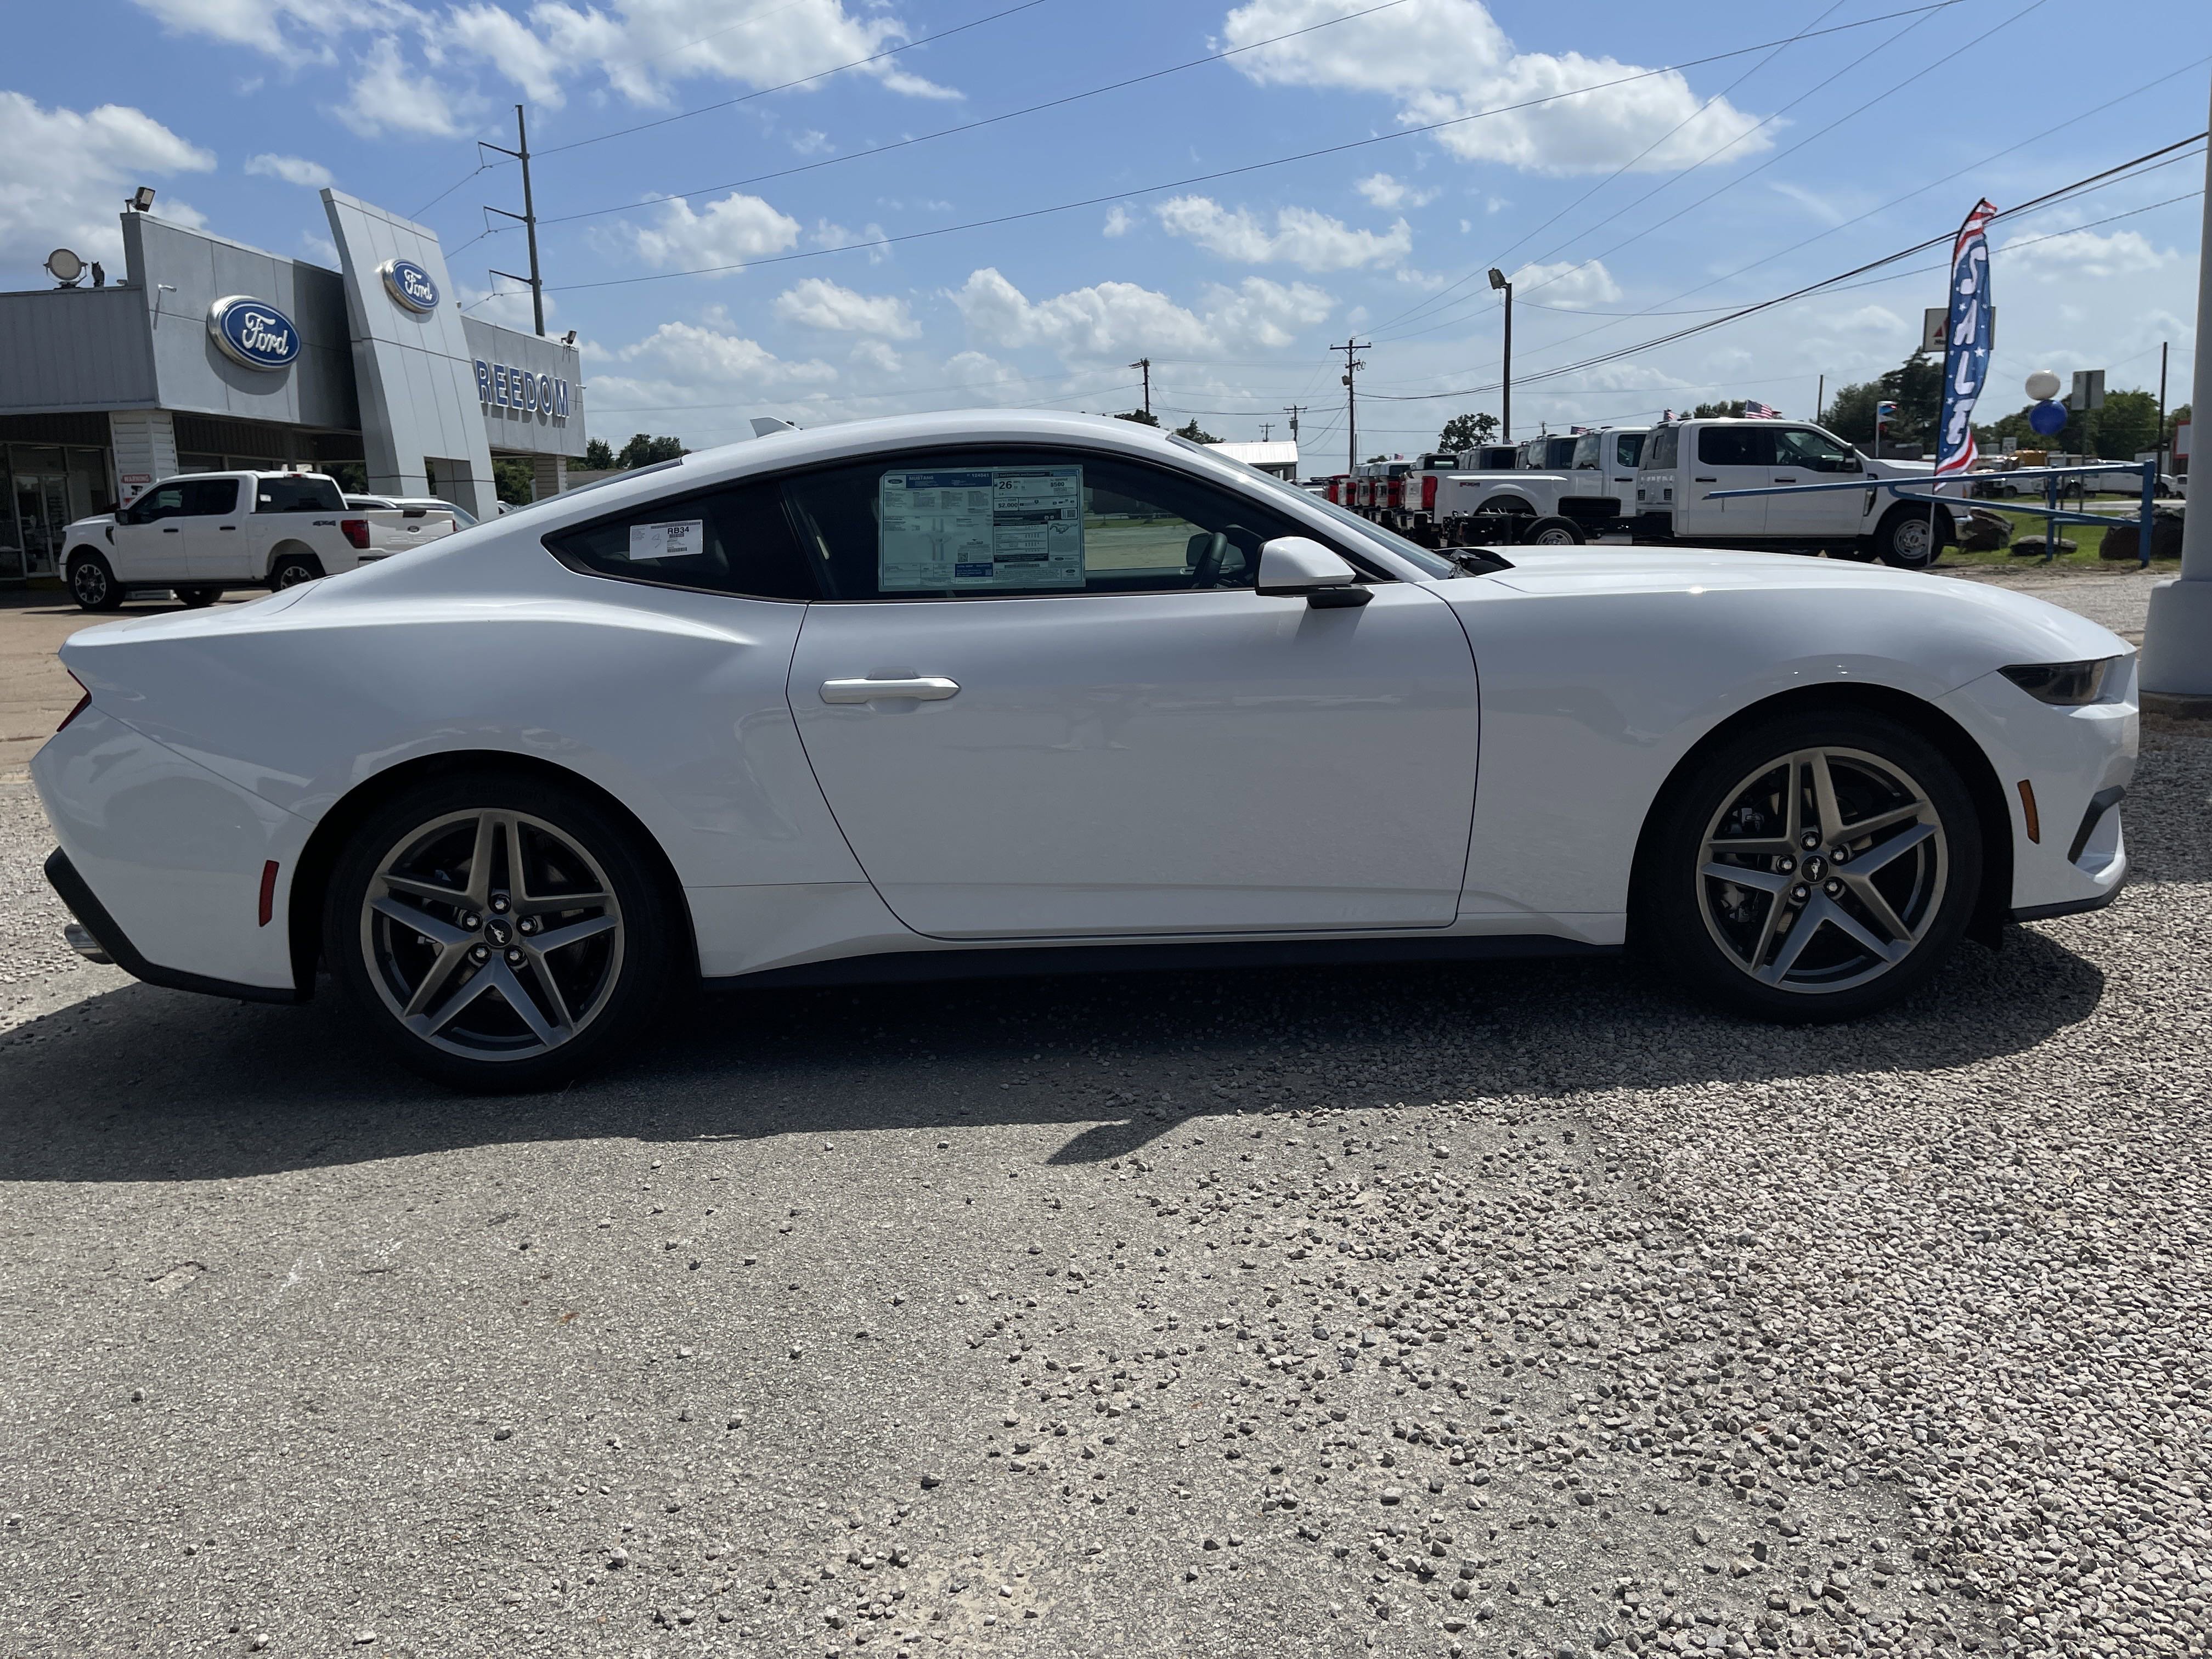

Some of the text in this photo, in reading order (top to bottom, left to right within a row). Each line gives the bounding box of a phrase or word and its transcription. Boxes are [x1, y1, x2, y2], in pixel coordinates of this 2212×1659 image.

[404, 269, 433, 301] Ford
[242, 312, 289, 356] Ford
[1946, 245, 1987, 444] SALE
[475, 358, 570, 419] REEDOM
[998, 481, 1013, 490] 26
